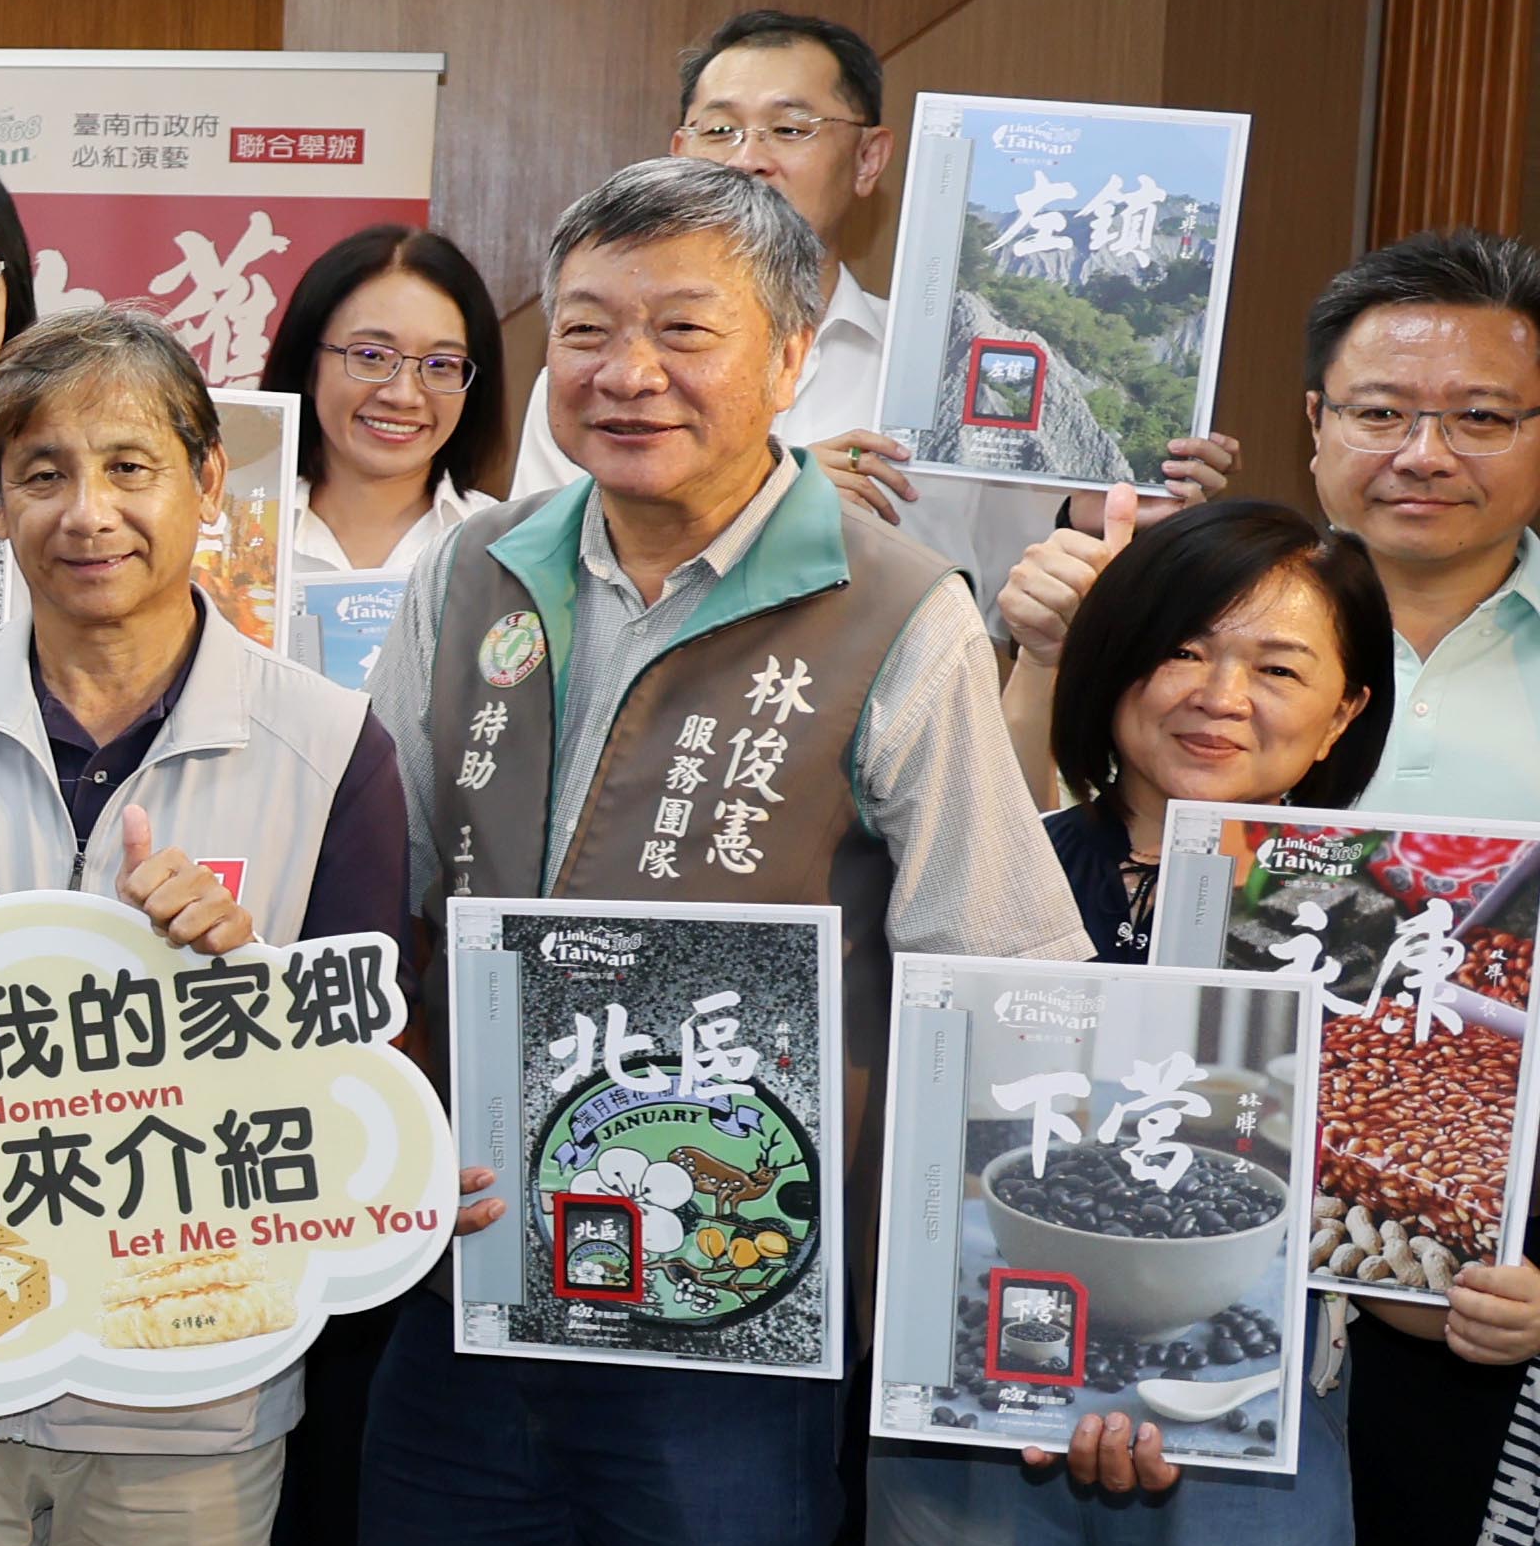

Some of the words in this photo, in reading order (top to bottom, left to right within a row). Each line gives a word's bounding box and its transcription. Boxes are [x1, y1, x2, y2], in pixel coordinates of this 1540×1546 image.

[73, 113, 219, 137] 臺南市政府
[72, 145, 190, 169] 必紅演藝
[237, 134, 357, 159] 聯合舉辦
[1006, 134, 1074, 155] Taiwan
[982, 169, 1167, 268] 左鎮
[456, 701, 509, 790] 特助
[706, 654, 815, 874] 林俊憲
[638, 714, 717, 879] 服務團隊
[1277, 838, 1329, 859] Linking
[1273, 851, 1354, 876] Taiwan
[559, 930, 610, 949] Linking
[556, 943, 636, 966] Taiwan
[1268, 897, 1464, 1044] 永康
[1015, 989, 1070, 1012] Linking
[1011, 1004, 1098, 1030] Taiwan
[548, 990, 761, 1098] 北區
[601, 1109, 703, 1140] JANUARY
[991, 1051, 1213, 1192] 下營
[108, 1226, 166, 1259] Let
[179, 1218, 237, 1253] Me
[251, 1210, 364, 1247] Show
[374, 1203, 439, 1237] You
